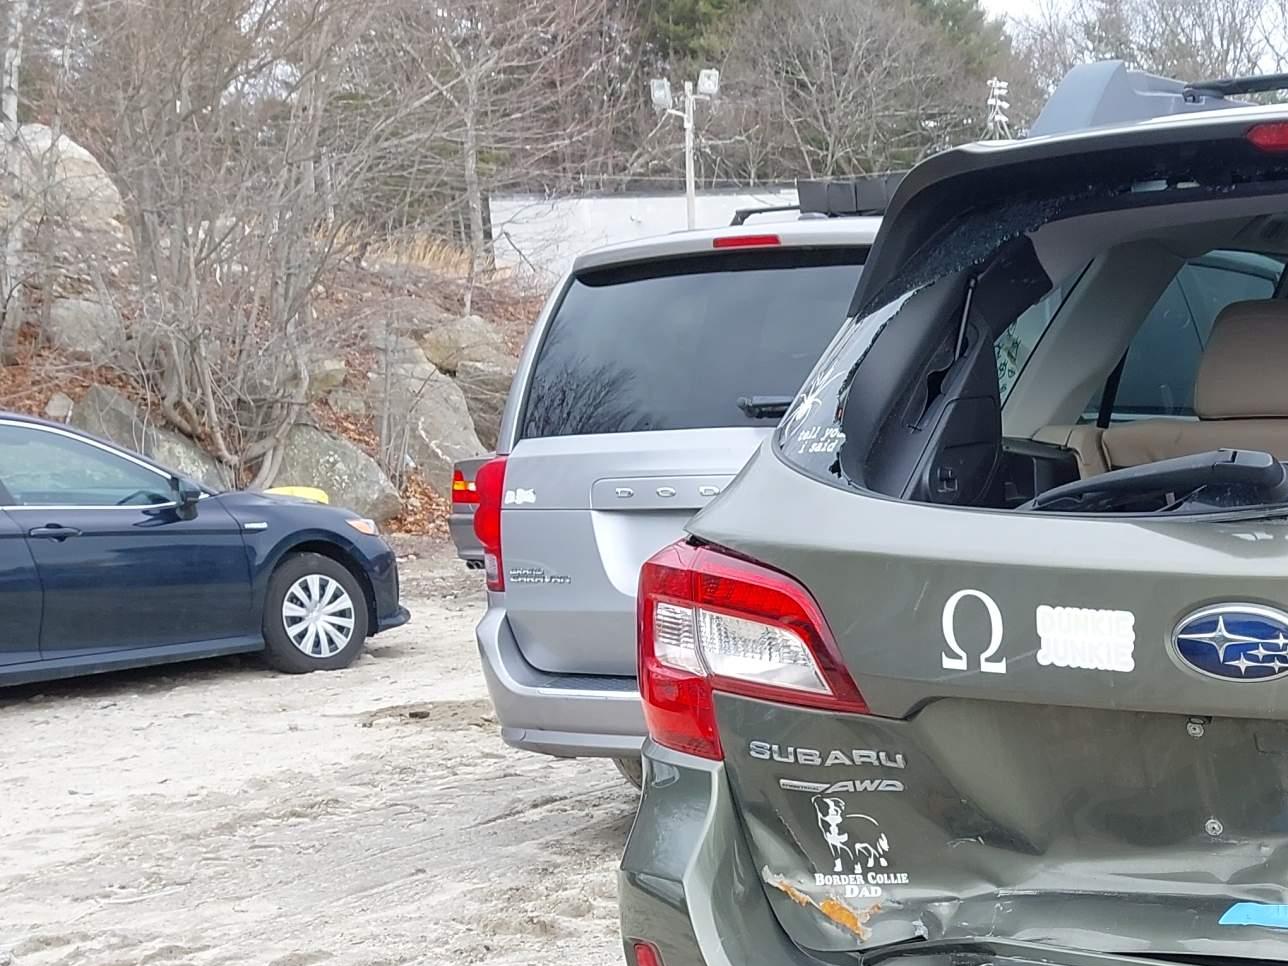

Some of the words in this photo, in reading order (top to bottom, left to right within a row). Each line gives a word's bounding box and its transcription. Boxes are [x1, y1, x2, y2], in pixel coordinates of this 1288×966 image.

[798, 426, 821, 441] tell
[808, 439, 838, 453] said
[1038, 638, 1132, 669] JUNKIE
[749, 740, 906, 769] SUBARU
[824, 779, 905, 794] AWD
[814, 873, 865, 886] BORDER
[867, 872, 909, 884] COLLIE
[844, 885, 882, 898] DAD
